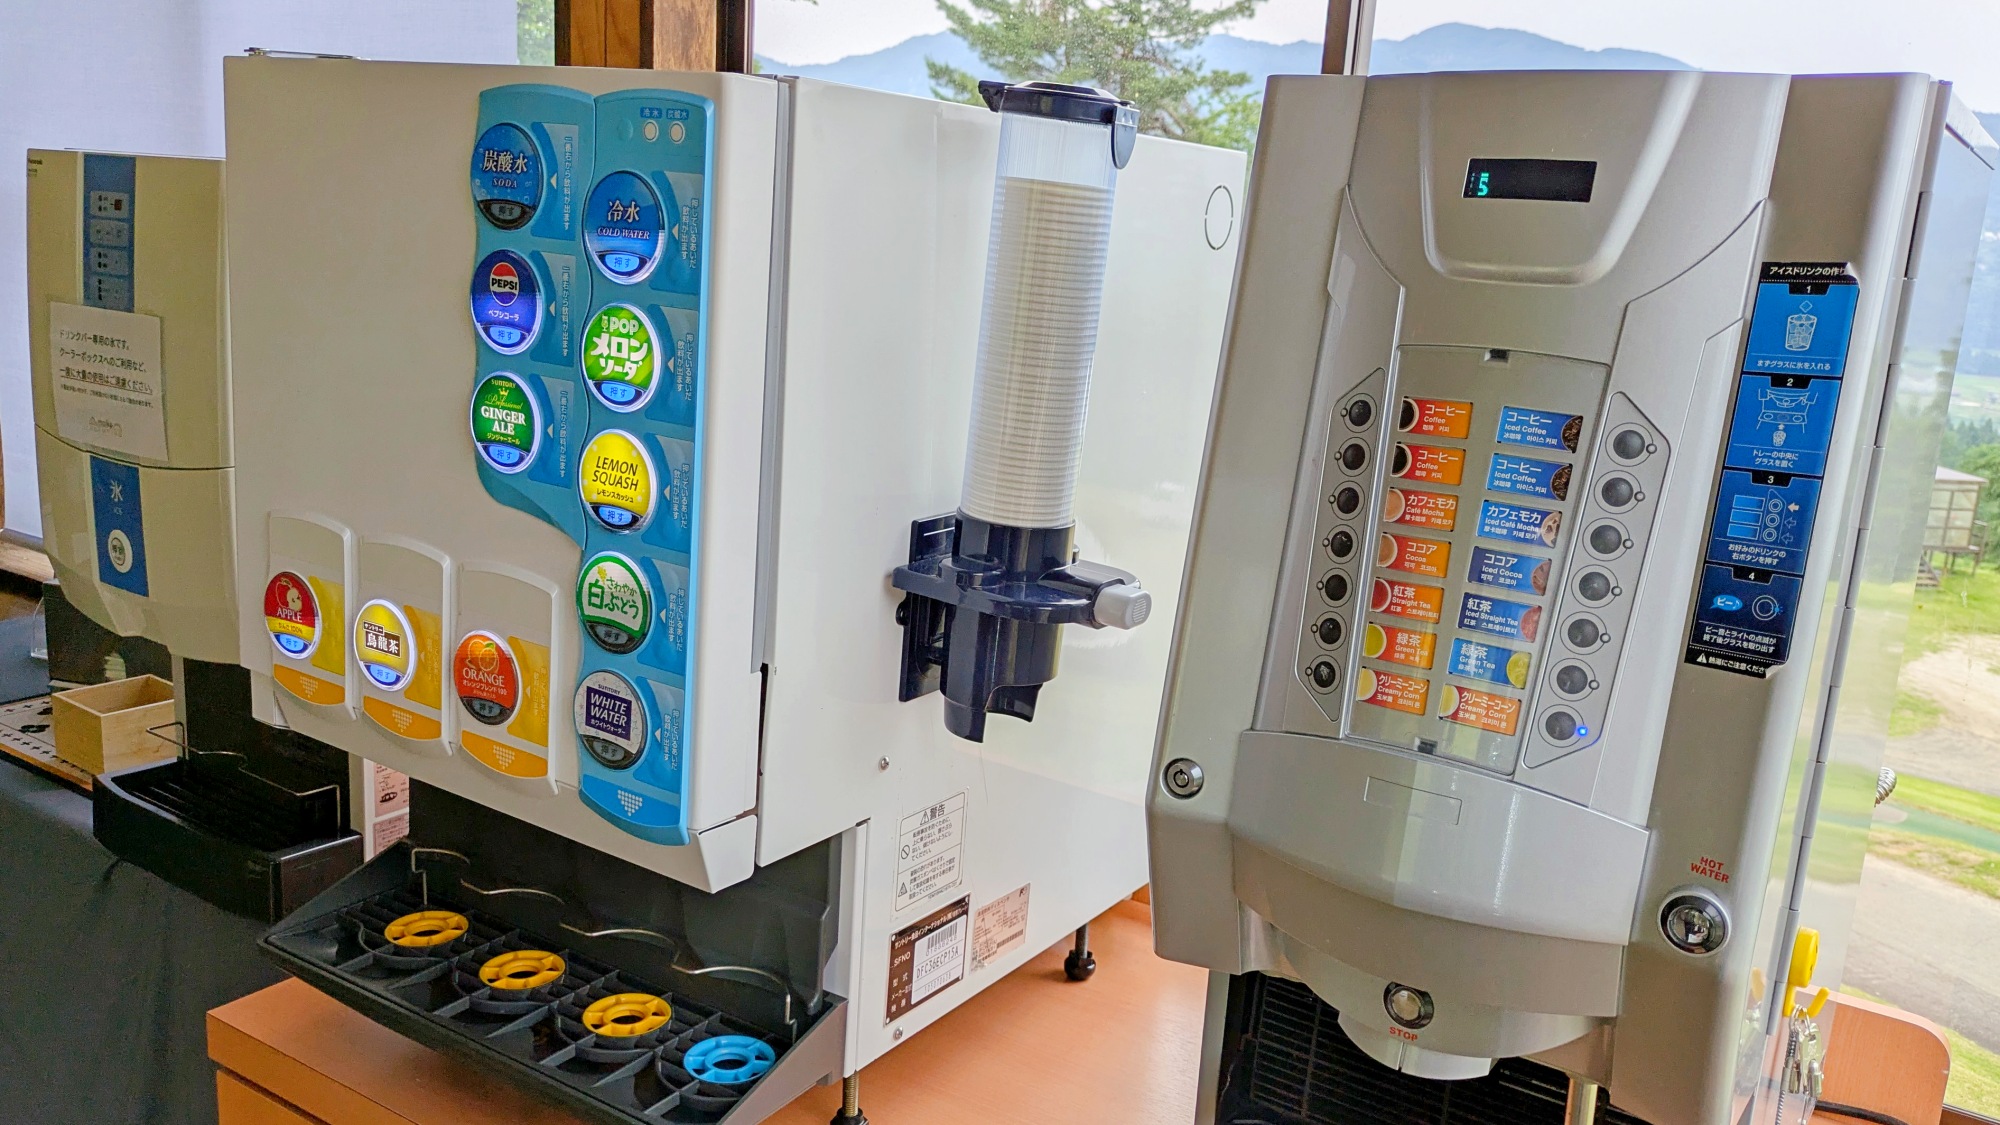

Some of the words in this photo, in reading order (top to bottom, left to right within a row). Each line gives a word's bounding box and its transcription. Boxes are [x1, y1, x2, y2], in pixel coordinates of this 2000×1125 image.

[483, 150, 528, 173] 炭酸水
[493, 178, 517, 188] SODA
[1477, 175, 1490, 196] 5
[607, 200, 640, 222] 冷水
[598, 227, 620, 237] COLD
[622, 229, 650, 239] WATER
[614, 257, 632, 268] 押す
[1769, 266, 1846, 276] アイスドリンクの作り
[491, 278, 517, 290] PEPSI
[1806, 285, 1812, 293] 1
[489, 310, 519, 321] ペプシコーラ
[610, 316, 639, 335] POP
[497, 330, 513, 340] 押す
[591, 332, 648, 361] メロン
[599, 358, 642, 380] ソーダ
[1757, 359, 1831, 370] まずグラスに氷を入れる
[1786, 378, 1794, 387] 2
[610, 387, 627, 398] 押す
[481, 405, 526, 426] GINGER
[1425, 404, 1466, 417] コーヒー
[1424, 416, 1446, 424] Coffee
[1507, 412, 1552, 425] コーヒー
[492, 420, 514, 435] ALE
[1504, 423, 1520, 431] Iced
[1522, 425, 1547, 435] Coffee
[487, 432, 520, 445] ジンジャーエール
[496, 449, 512, 460] 押す
[1418, 450, 1458, 463] コーヒー
[1753, 450, 1798, 461] トレーの中央に
[595, 456, 638, 477] LEMON
[1416, 462, 1438, 470] Coffee
[1496, 459, 1542, 474] コーヒー
[1754, 457, 1794, 468] グラスを置く
[592, 470, 639, 492] SQUASH
[1494, 471, 1510, 479] Iced
[1511, 473, 1536, 483] Coffee
[1767, 475, 1775, 484] 3
[110, 480, 123, 502] 氷
[596, 488, 634, 503] レモンスカッシュ
[1407, 495, 1457, 510] カフェモカ
[607, 510, 624, 523] 押す
[1406, 506, 1421, 514] Café
[1421, 508, 1444, 517] Mocha
[1487, 506, 1541, 524] カフェモカ
[1485, 517, 1499, 526] Iced
[1500, 520, 1515, 529] Café
[1516, 522, 1539, 532] Mocha
[1407, 542, 1437, 555] ココア
[1728, 543, 1786, 558] お好みのドリンクの
[1405, 554, 1427, 562] Cocoa
[1484, 553, 1518, 567] ココア
[1732, 552, 1779, 566] 右ボタンを押す
[1482, 565, 1498, 574] Iced
[1499, 568, 1523, 578] Cocoa
[1749, 572, 1755, 581] 4
[606, 577, 637, 597] さわやか
[1393, 585, 1416, 599] 紅茶
[587, 579, 639, 619] 白ぶどう
[1392, 597, 1418, 607] Straight
[1467, 597, 1492, 613] 紅茶
[277, 606, 302, 623] APPLE
[1465, 609, 1479, 618] Iced
[1480, 612, 1506, 624] Straight
[1507, 618, 1518, 626] Tea
[367, 633, 399, 653] 烏龍茶
[1396, 632, 1422, 647] 緑茶
[1395, 644, 1415, 654] Green
[1416, 648, 1428, 657] Tea
[1482, 660, 1495, 669] Tea
[1708, 656, 1766, 674] 熱湯にご注意くださ
[463, 667, 505, 687] ORANGE
[1378, 674, 1427, 693] クリーミーコーン
[1377, 685, 1402, 697] Creamy
[1403, 690, 1420, 700] Corn
[590, 692, 627, 714] WHITE
[1461, 691, 1516, 713] クリーミーコーン
[590, 705, 627, 727] WATER
[1460, 702, 1487, 715] Creamy
[1488, 710, 1506, 719] Corn
[590, 719, 626, 734] ホワイトウォーター
[930, 804, 945, 820] 警告
[1700, 857, 1724, 871] HOT
[1690, 863, 1730, 883] WATER
[916, 945, 959, 978] DFC36ECP15A
[1389, 1026, 1418, 1041] STOP
